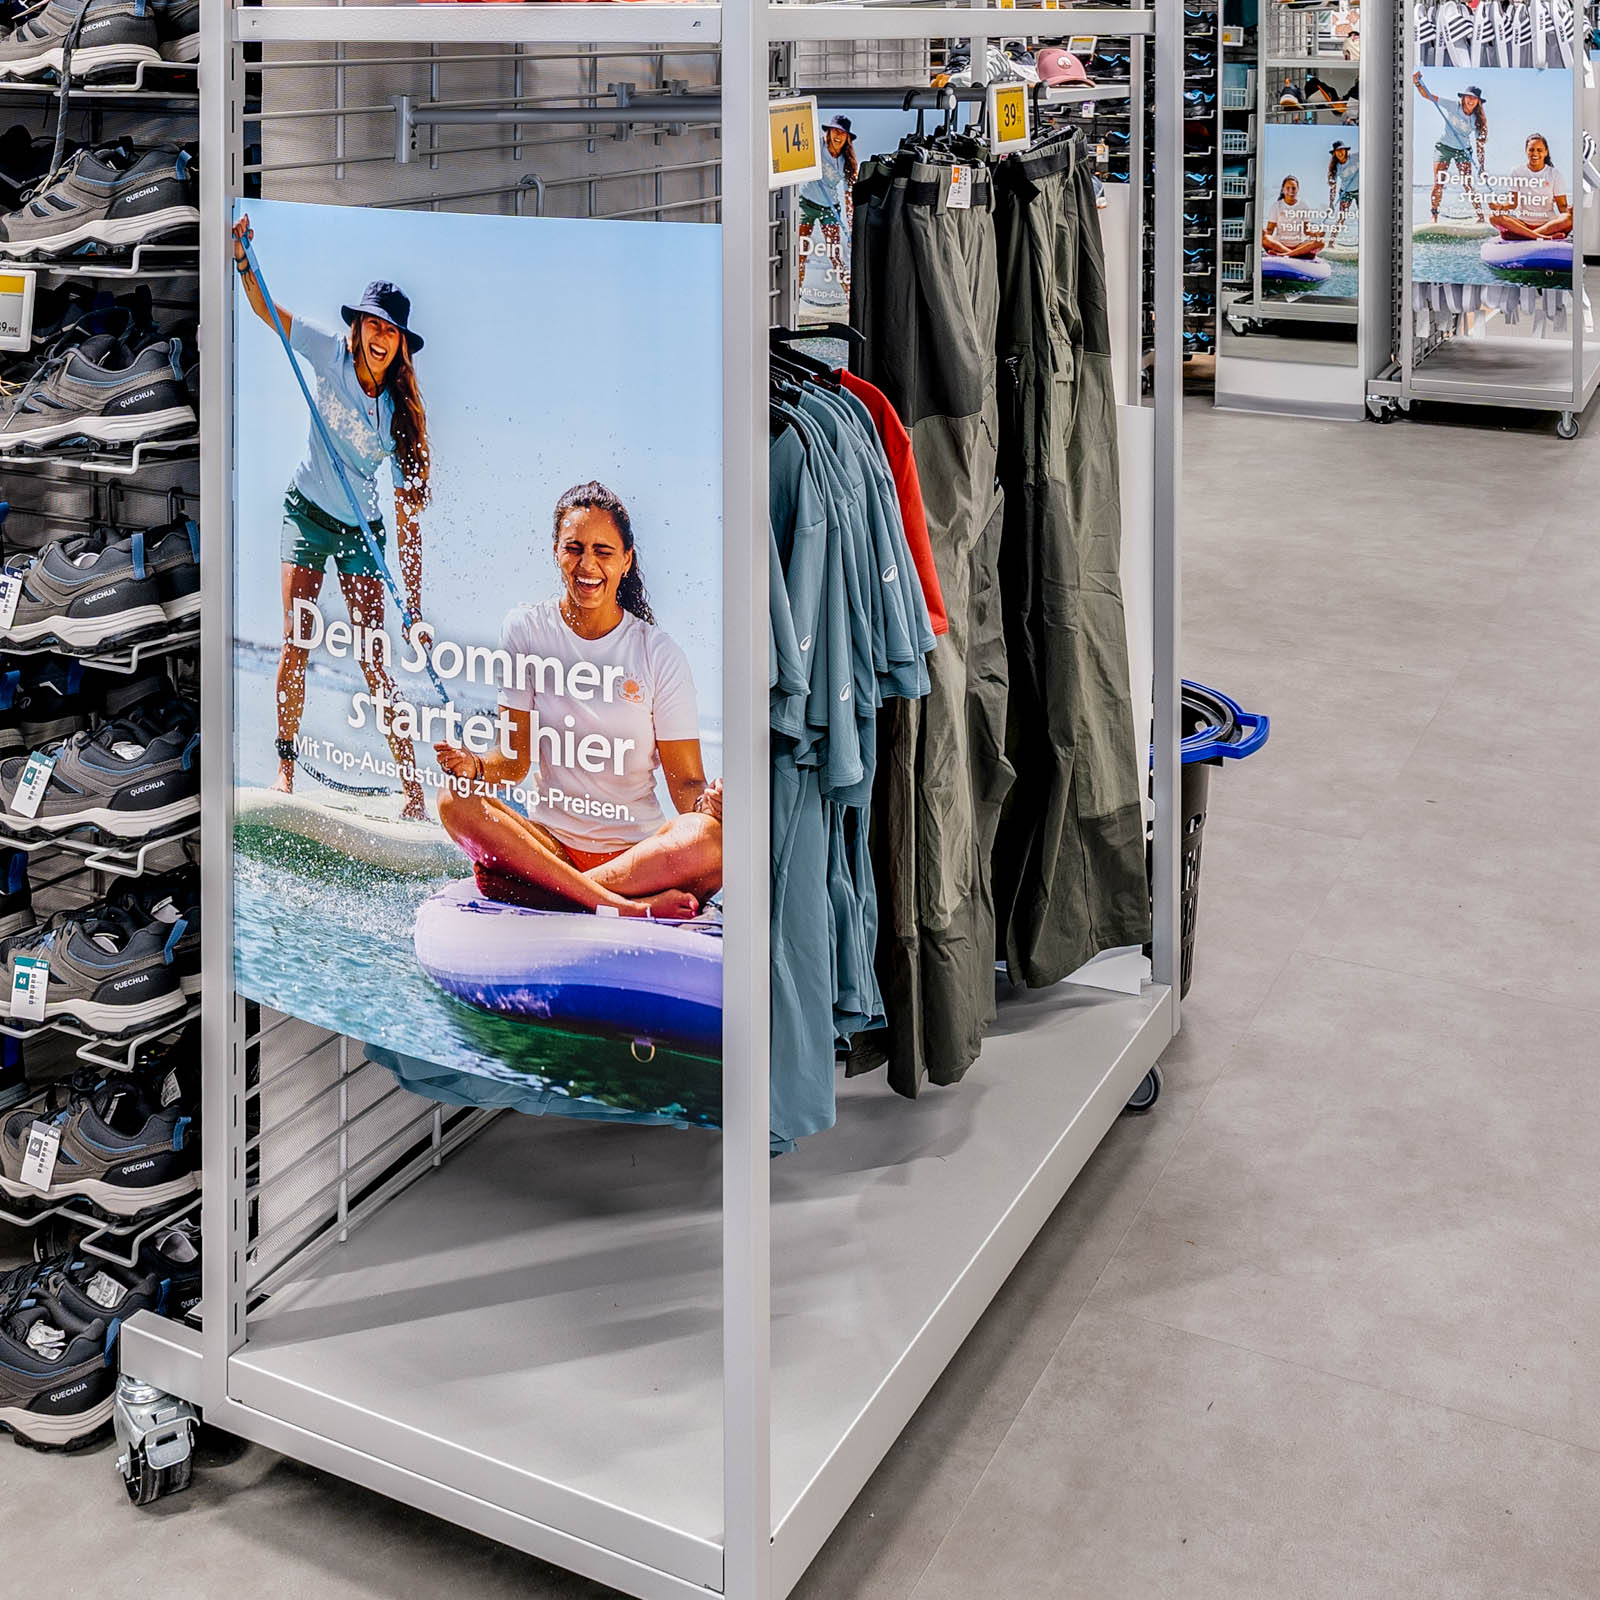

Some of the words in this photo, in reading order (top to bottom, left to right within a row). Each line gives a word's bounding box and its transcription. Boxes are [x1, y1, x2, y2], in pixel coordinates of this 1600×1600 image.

[80, 19, 111, 34] QUECHUA
[1437, 170, 1474, 185] Dein
[1477, 172, 1546, 188] Sommer
[124, 185, 160, 204] QUECHUA
[1459, 191, 1515, 205] startet
[1518, 191, 1549, 206] hier
[799, 235, 844, 258] Dein
[119, 390, 157, 408] QUECHUA
[84, 586, 118, 605] QUECHUA
[291, 596, 393, 668] Dein
[401, 621, 625, 704] Sommer
[348, 691, 518, 761] startet
[529, 710, 636, 777] hier
[293, 730, 319, 761] Mit
[322, 739, 472, 800] Top-Ausrüstung
[473, 777, 499, 800] zu
[501, 779, 636, 823] Top-Preisen.
[129, 780, 166, 797] QUECHUA
[113, 974, 150, 992] QUECHUA
[122, 1159, 156, 1175] QUECHUA
[50, 1383, 88, 1402] QUECHUA
